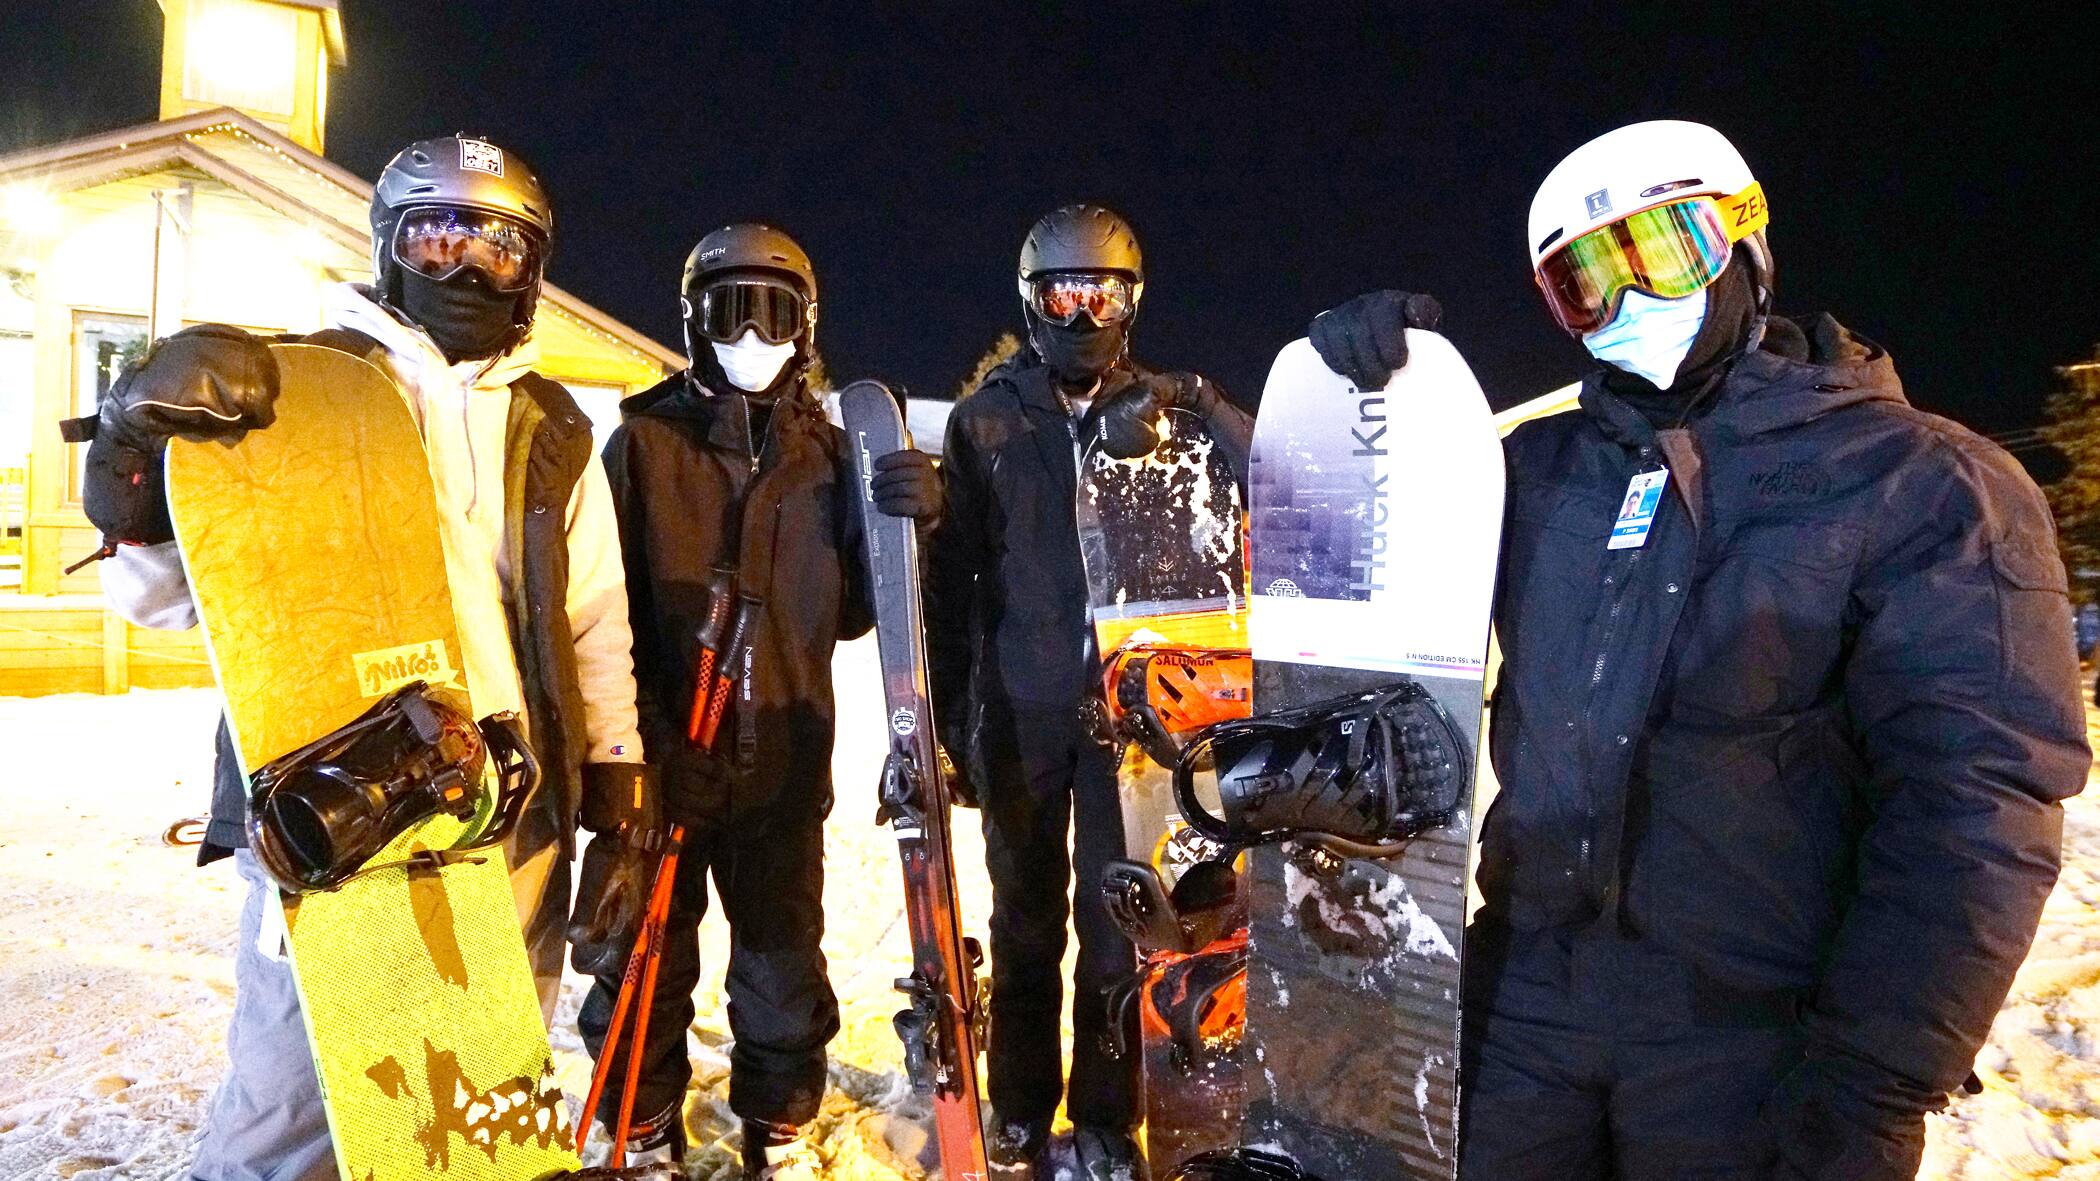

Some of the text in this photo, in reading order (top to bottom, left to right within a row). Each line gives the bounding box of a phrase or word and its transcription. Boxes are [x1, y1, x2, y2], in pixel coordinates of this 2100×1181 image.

[701, 247, 726, 261] SMITH
[1100, 415, 1108, 440] KOMBI
[1350, 473, 1389, 592] Huck
[1155, 653, 1214, 667] SALOMON
[1418, 654, 1445, 662] EDITION
[743, 646, 754, 701] SEVEN
